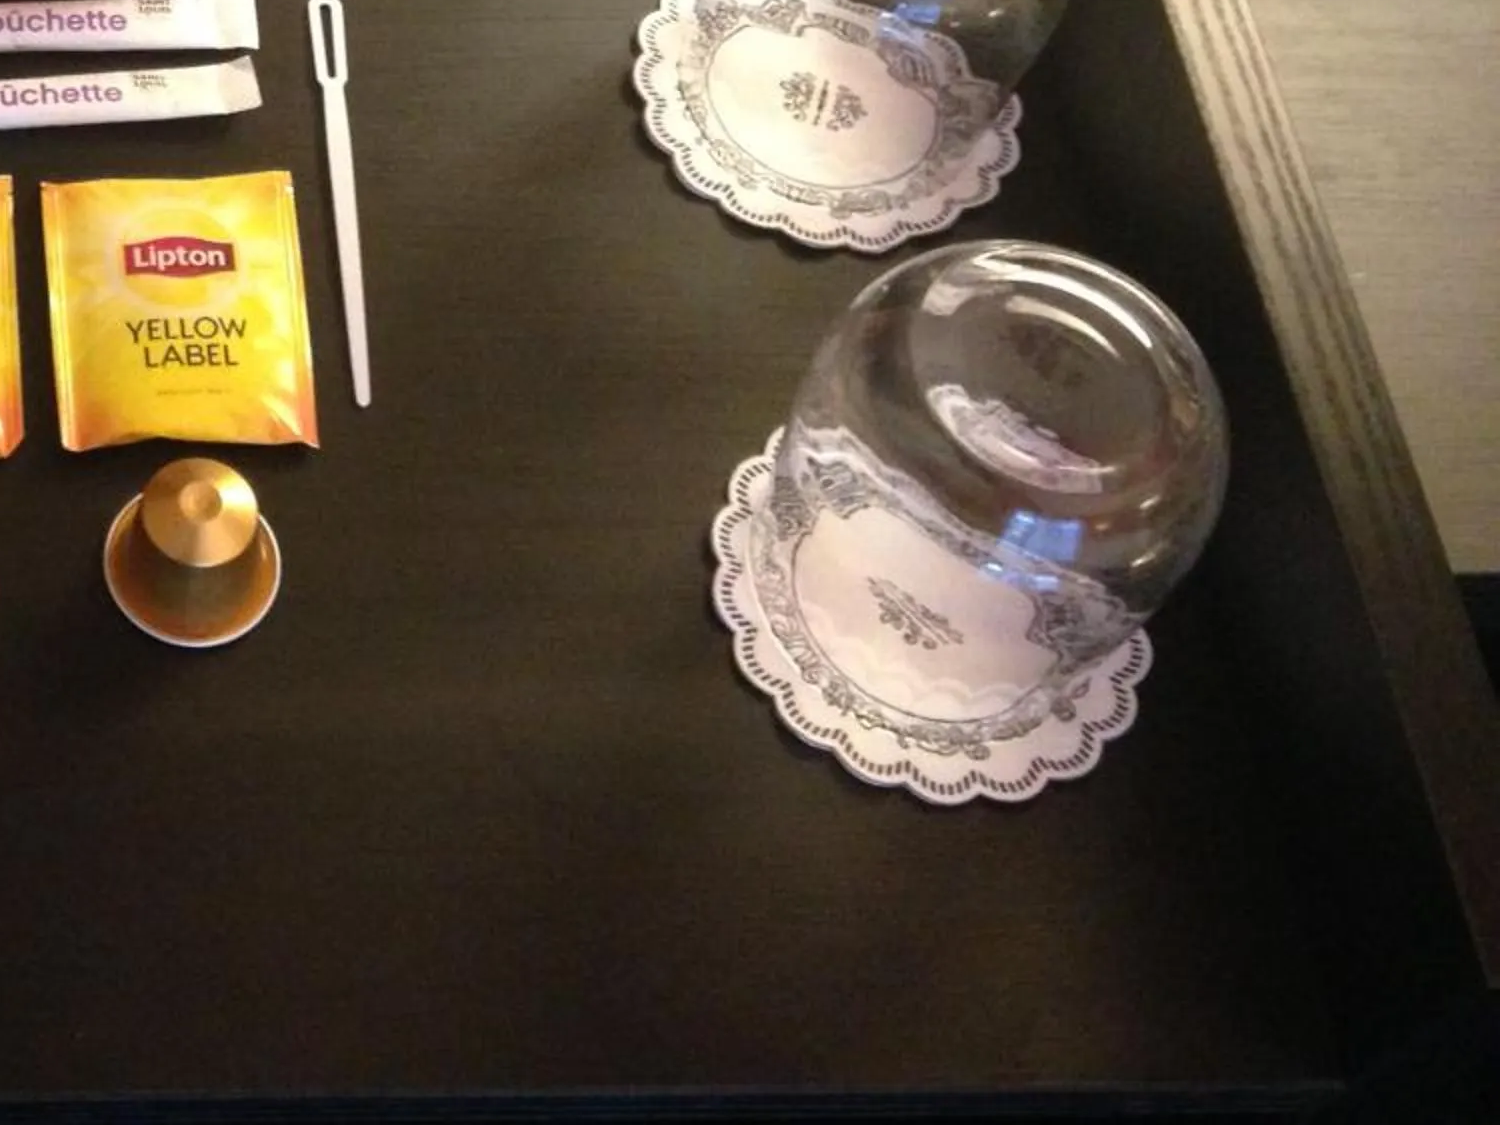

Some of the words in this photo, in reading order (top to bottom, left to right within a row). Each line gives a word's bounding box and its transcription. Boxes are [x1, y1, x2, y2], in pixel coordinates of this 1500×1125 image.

[133, 246, 226, 272] Lipton
[125, 316, 246, 344] YELLOW
[144, 343, 239, 368] LABEL
